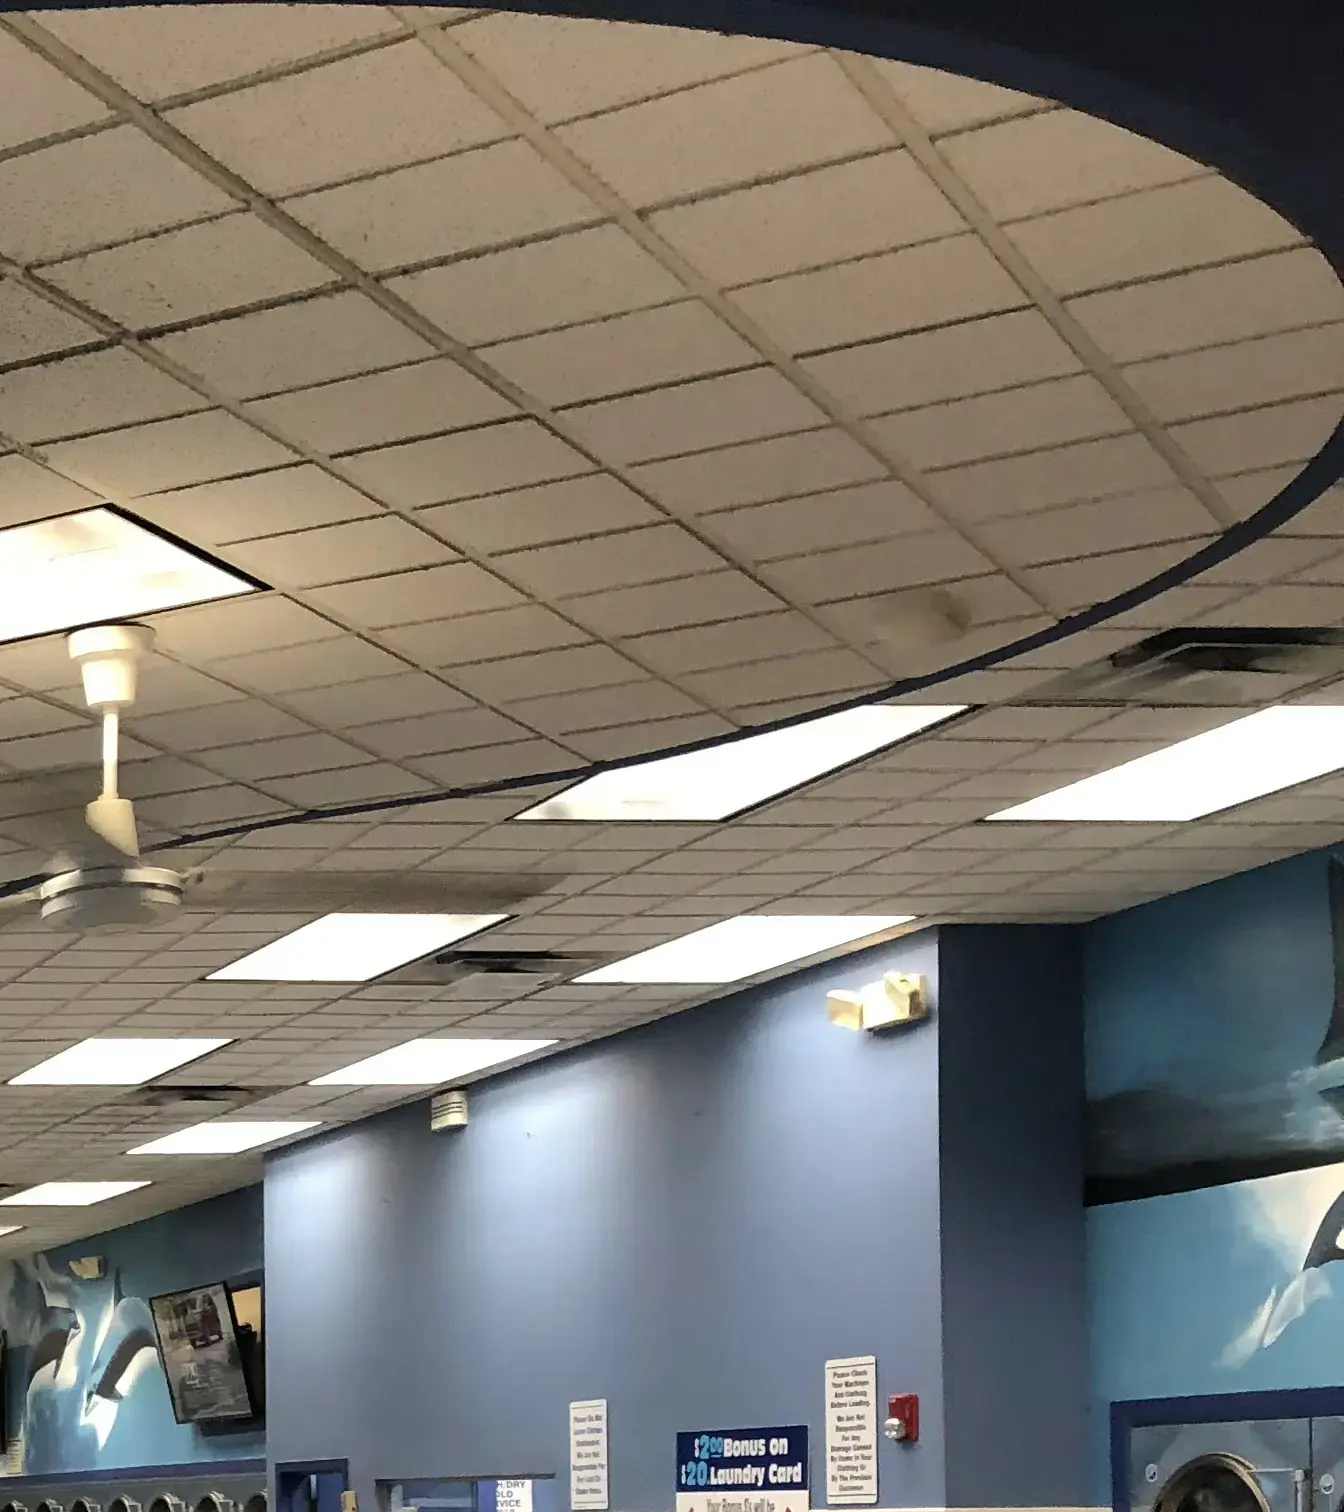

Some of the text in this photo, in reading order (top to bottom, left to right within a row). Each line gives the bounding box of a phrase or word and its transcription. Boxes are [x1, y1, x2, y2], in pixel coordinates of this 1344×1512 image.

[723, 1438, 766, 1458] Bonus
[769, 1437, 788, 1456] on
[710, 1463, 766, 1487] Laundry
[768, 1461, 803, 1484] Card
